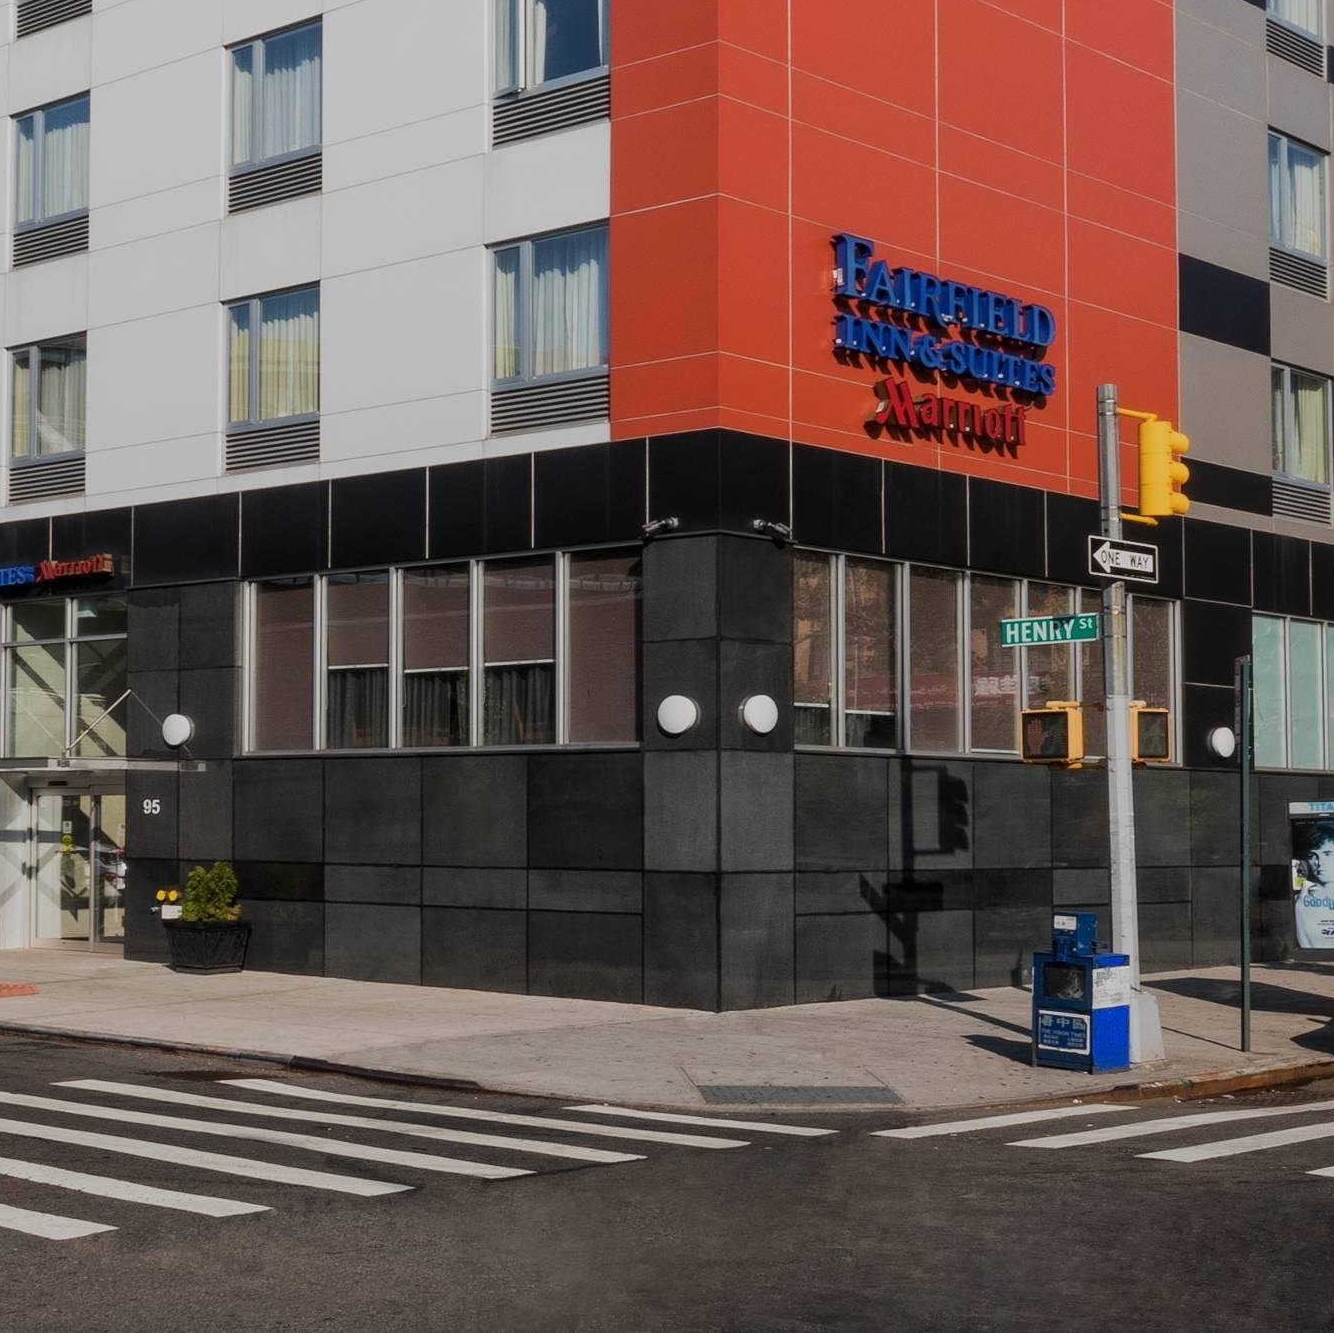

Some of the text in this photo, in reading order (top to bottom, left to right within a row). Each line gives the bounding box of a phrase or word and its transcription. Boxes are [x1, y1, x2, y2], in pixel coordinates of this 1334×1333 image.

[832, 314, 1056, 396] INN & SUITES
[872, 376, 1027, 446] Marriott
[1100, 549, 1150, 569] ONE WAY
[1006, 617, 1093, 644] HENRY St
[143, 799, 161, 815] 95
